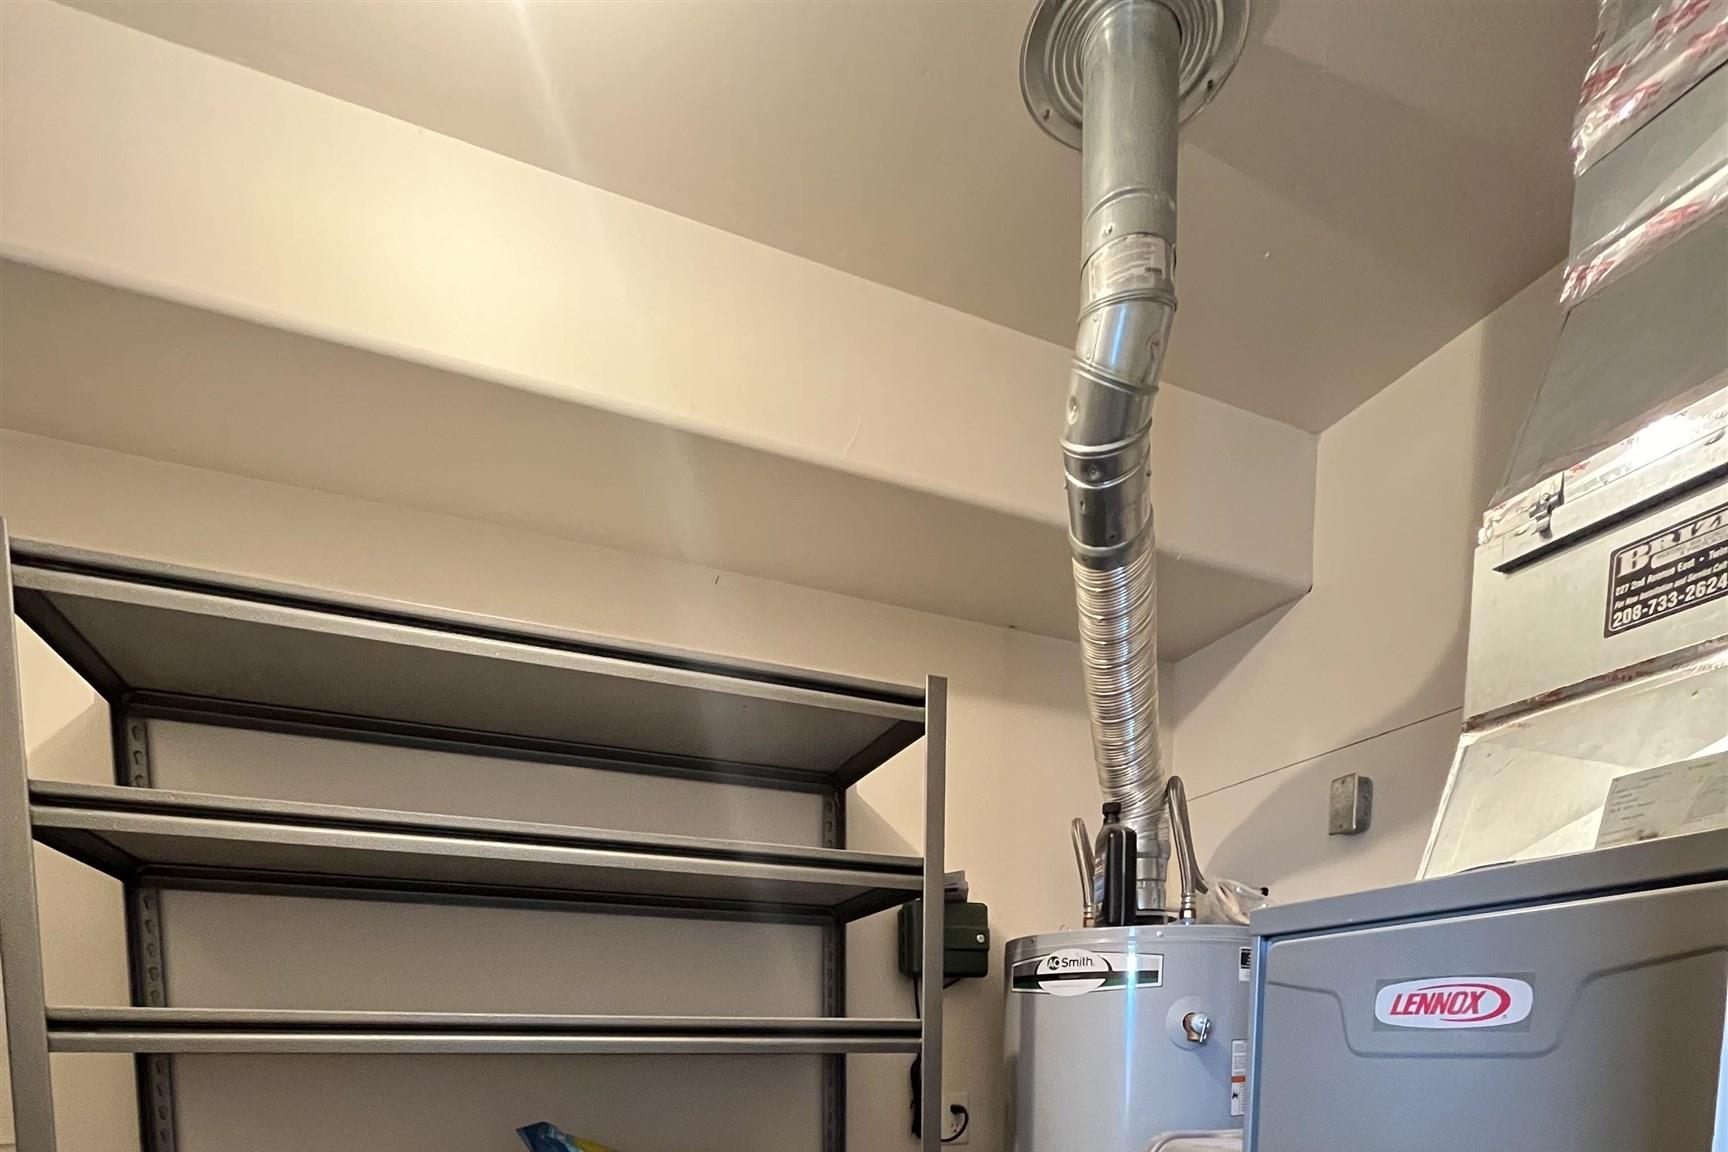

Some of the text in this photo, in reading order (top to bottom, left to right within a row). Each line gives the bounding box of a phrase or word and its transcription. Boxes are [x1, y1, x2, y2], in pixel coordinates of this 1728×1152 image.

[1612, 572, 1728, 628] 208-733-2624
[1062, 957, 1093, 968] Smith
[1389, 990, 1487, 1016] LENNOX
